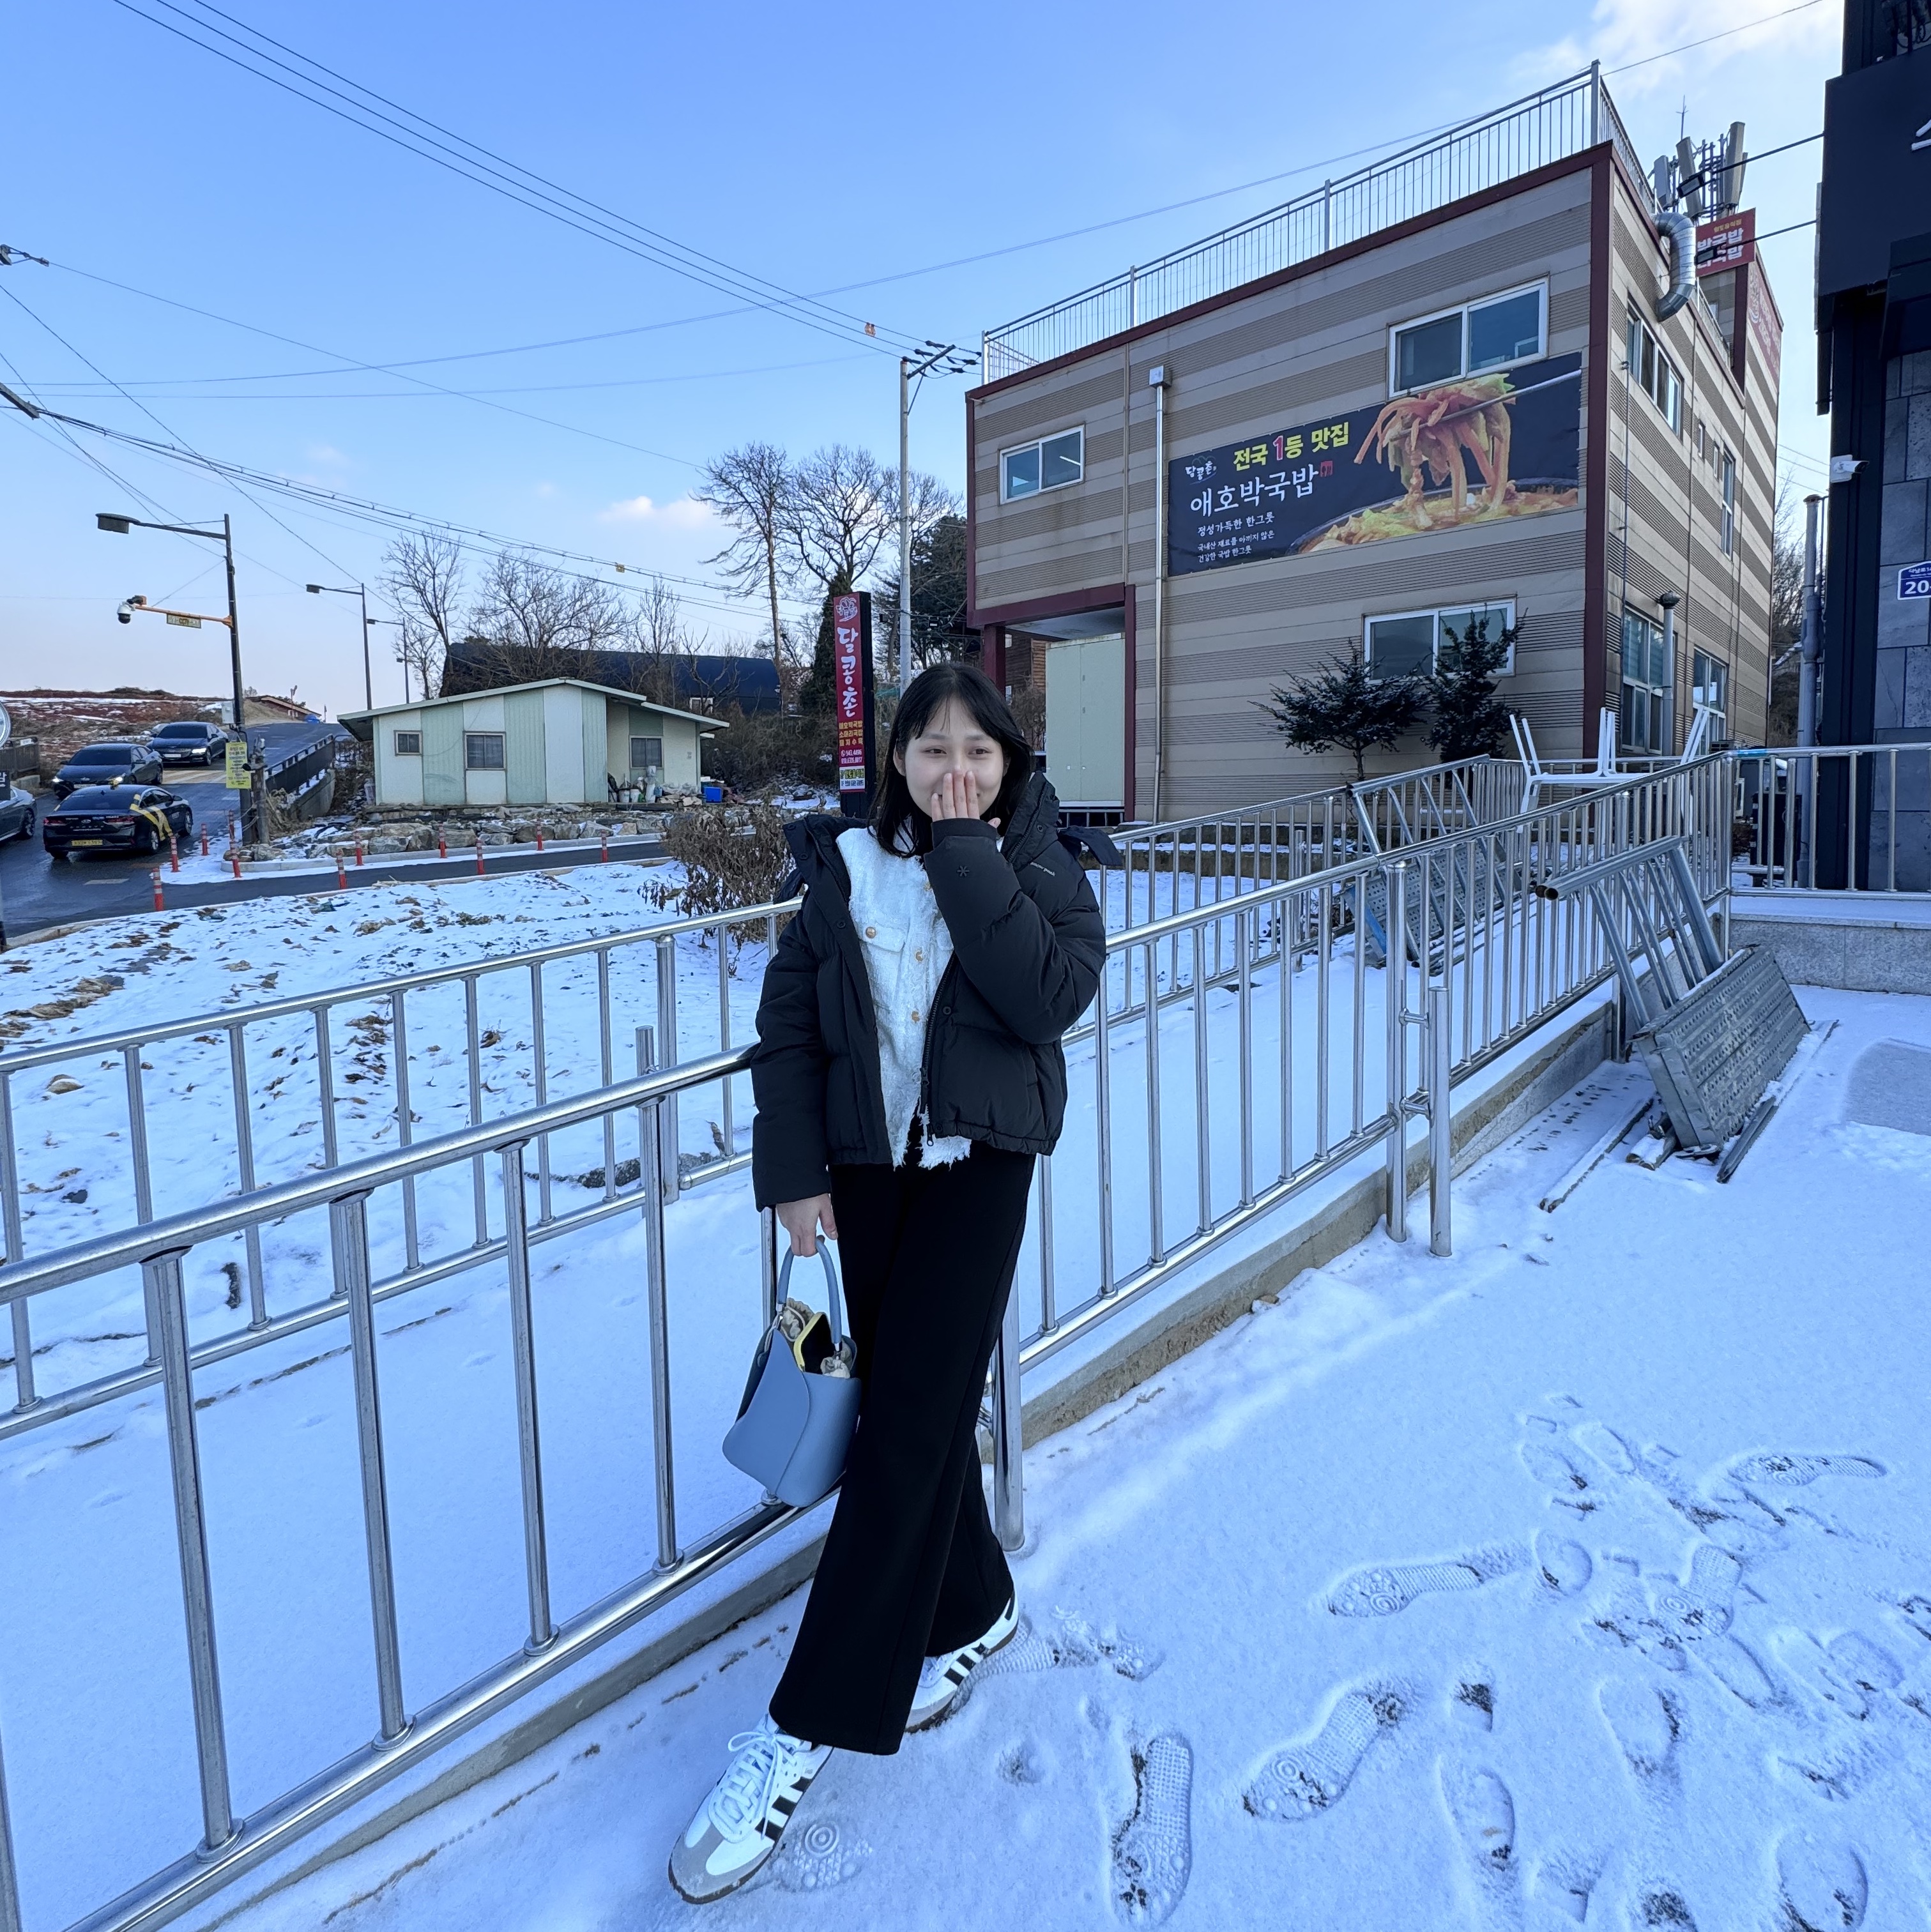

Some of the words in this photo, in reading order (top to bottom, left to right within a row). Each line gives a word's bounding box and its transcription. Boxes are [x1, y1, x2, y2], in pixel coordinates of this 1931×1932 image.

[1233, 443, 1269, 471] 전국
[1273, 435, 1304, 460] 1등
[1311, 422, 1349, 452] 맛집
[1190, 464, 1319, 517] 애호박국밥
[1198, 518, 1243, 536] 정성가득한
[1246, 512, 1275, 527] 한그릇
[1198, 541, 1216, 551] 국내산
[1217, 536, 1237, 547] 재료를
[1239, 533, 1259, 543] 아끼지
[1260, 530, 1275, 540] 않은
[1198, 552, 1216, 563] 건강한
[1217, 549, 1230, 558] 국밥
[1232, 545, 1252, 556] 한그릇
[1904, 580, 1931, 595] 20
[837, 627, 859, 717] 달콩촌
